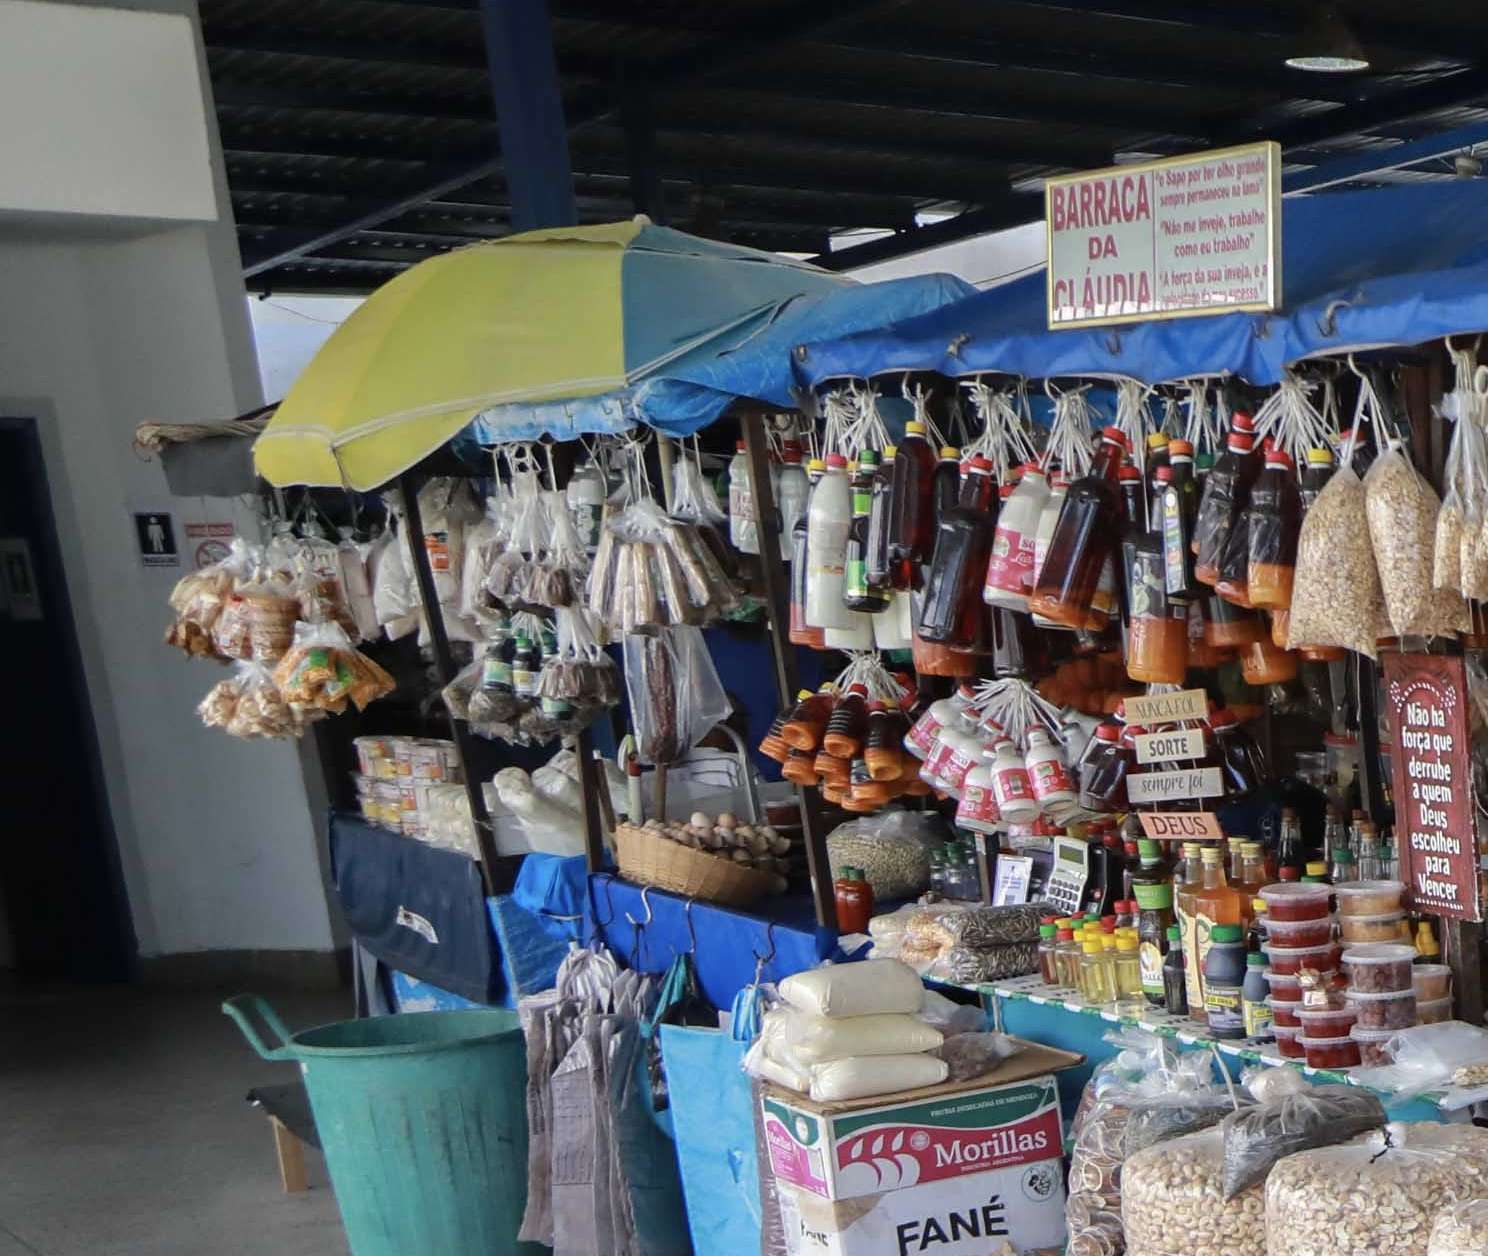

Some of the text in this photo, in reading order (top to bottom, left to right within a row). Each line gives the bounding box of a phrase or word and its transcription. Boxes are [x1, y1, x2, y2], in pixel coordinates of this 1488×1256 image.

[1053, 175, 1151, 232] BARRACA
[1088, 234, 1118, 260] DA
[1174, 242, 1199, 257] como
[1054, 267, 1152, 318] CLÁUDIA
[1407, 702, 1429, 726] Não
[1149, 737, 1189, 758] SORTE
[1402, 725, 1453, 758] força que
[1408, 755, 1452, 782] derrube
[1141, 776, 1185, 796] sempre
[1412, 782, 1453, 806] a quem
[1149, 816, 1208, 836] DEUS
[1419, 803, 1448, 829] Deus
[1411, 830, 1461, 855] escolheu
[1424, 855, 1451, 877] para
[1417, 872, 1458, 901] Vencer
[933, 1129, 1048, 1168] Morillas
